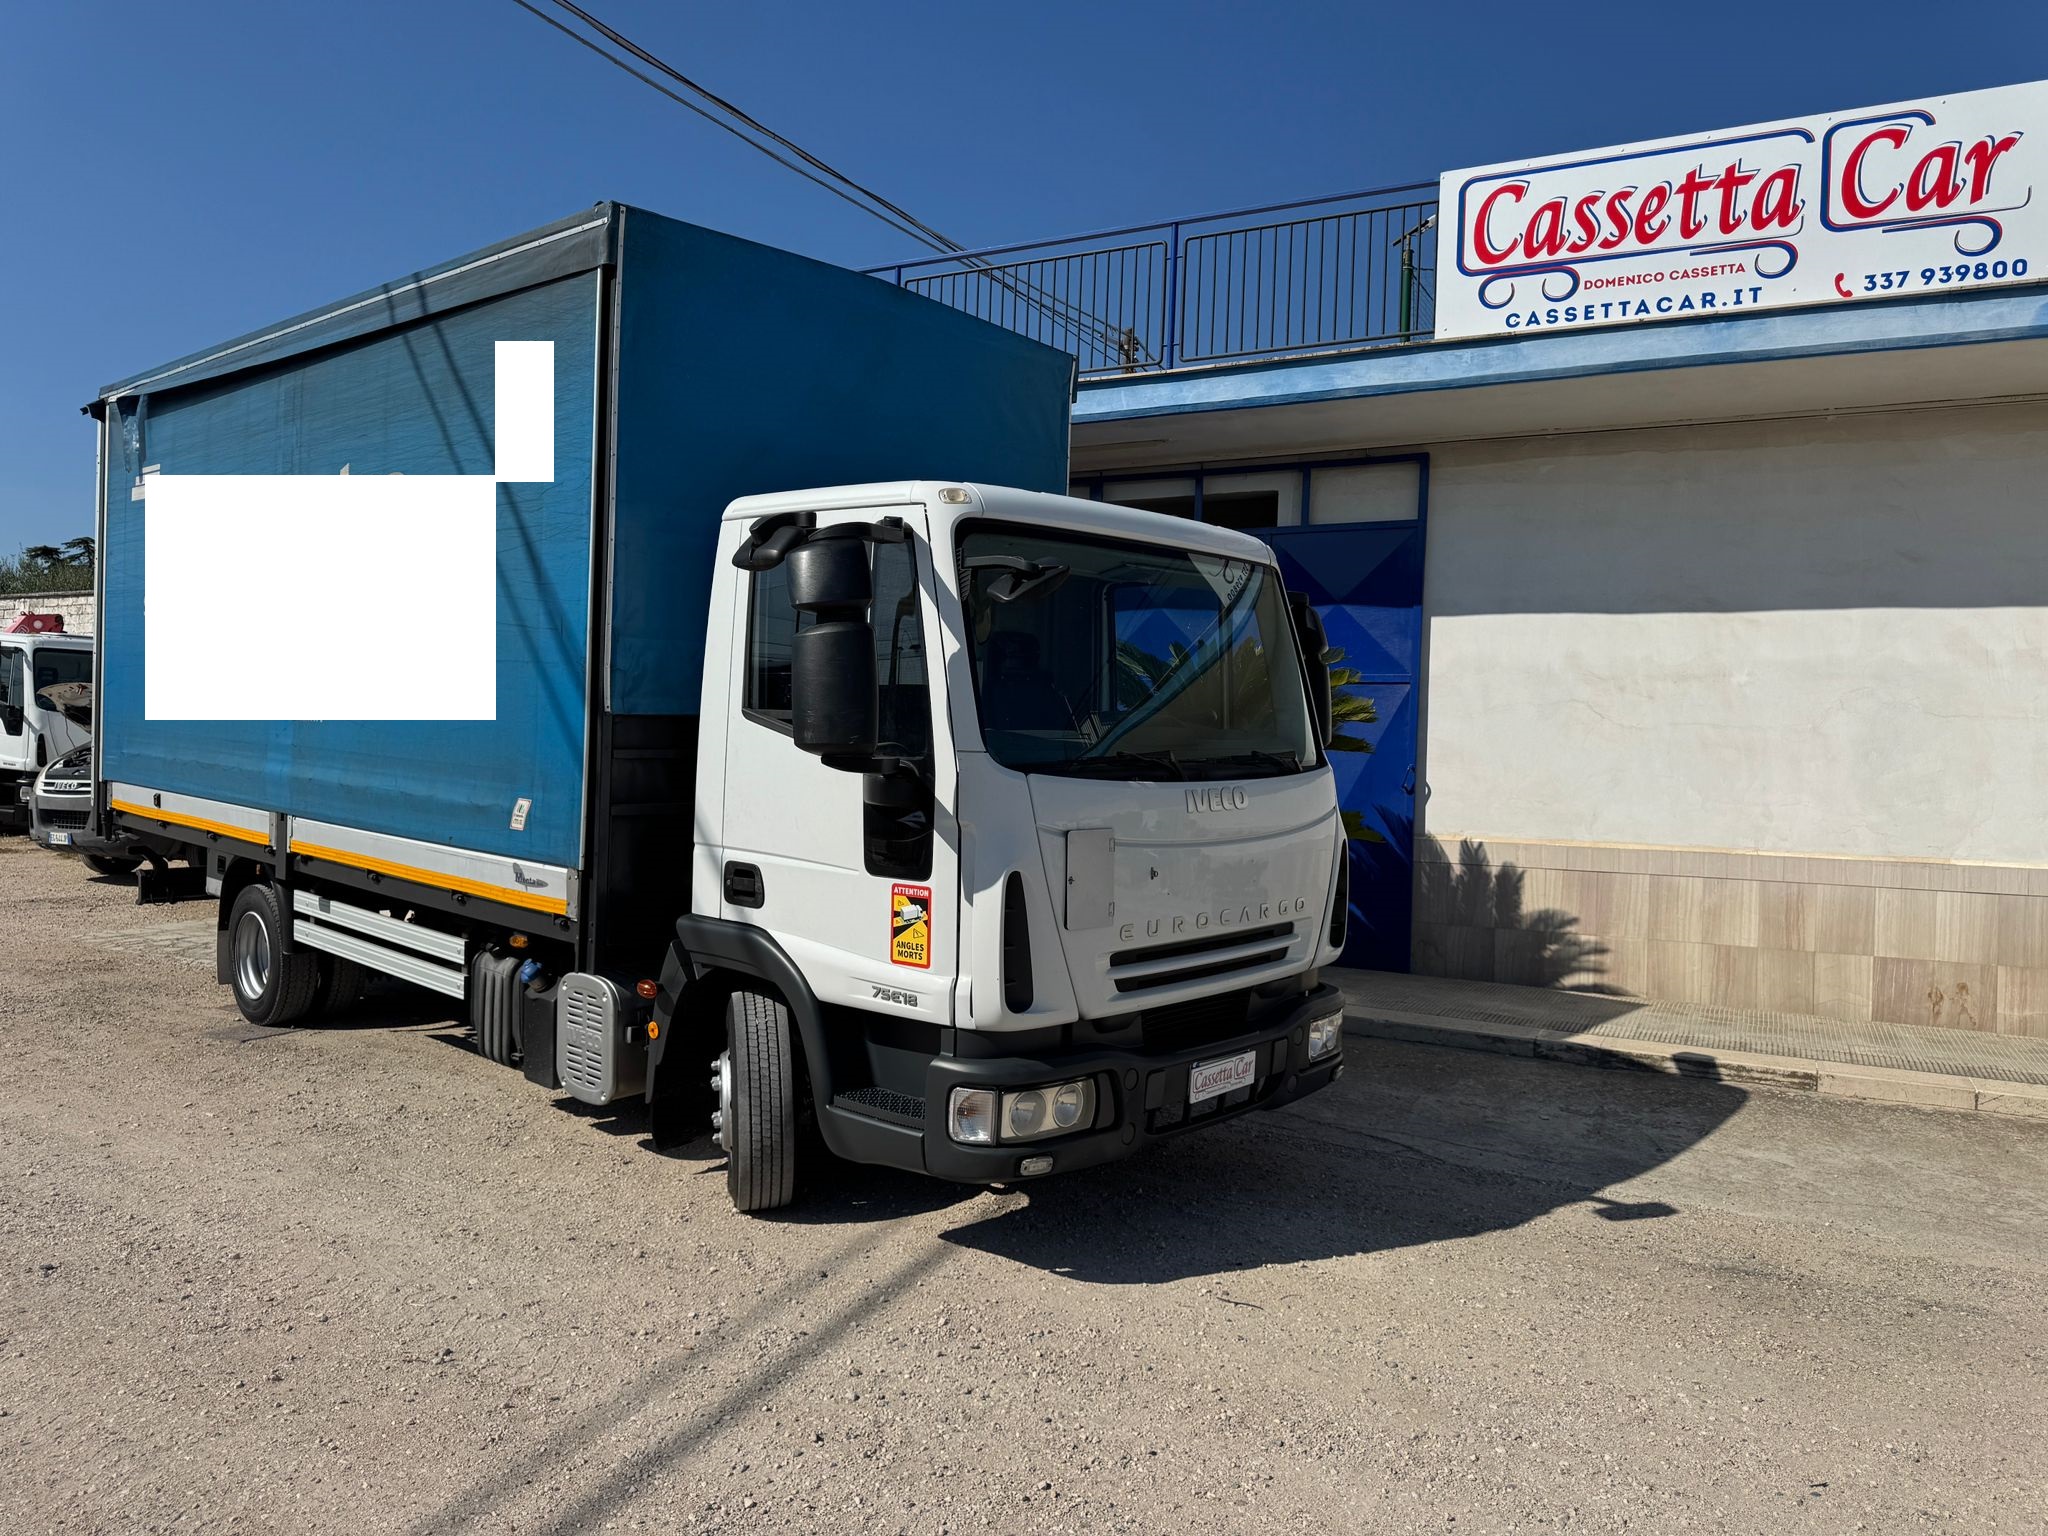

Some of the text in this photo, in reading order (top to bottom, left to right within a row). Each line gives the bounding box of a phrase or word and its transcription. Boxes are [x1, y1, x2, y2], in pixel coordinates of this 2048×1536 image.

[1473, 123, 2024, 265] Cassetta Car
[1583, 262, 1746, 291] DOMENICO CASSETTA
[1863, 258, 2028, 291] 337 939800
[1505, 286, 1763, 329] CASSETTACAR.IT
[54, 781, 78, 790] IVECO
[1185, 785, 1249, 814] IVECO
[893, 885, 929, 897] ATTENTION
[1119, 896, 1306, 942] EUROCARGO
[895, 940, 925, 952] ANGLES
[897, 949, 923, 960] MORTS
[871, 984, 919, 1008] 75E18
[1194, 1064, 1233, 1091] Cassetta
[1235, 1057, 1254, 1078] Car
